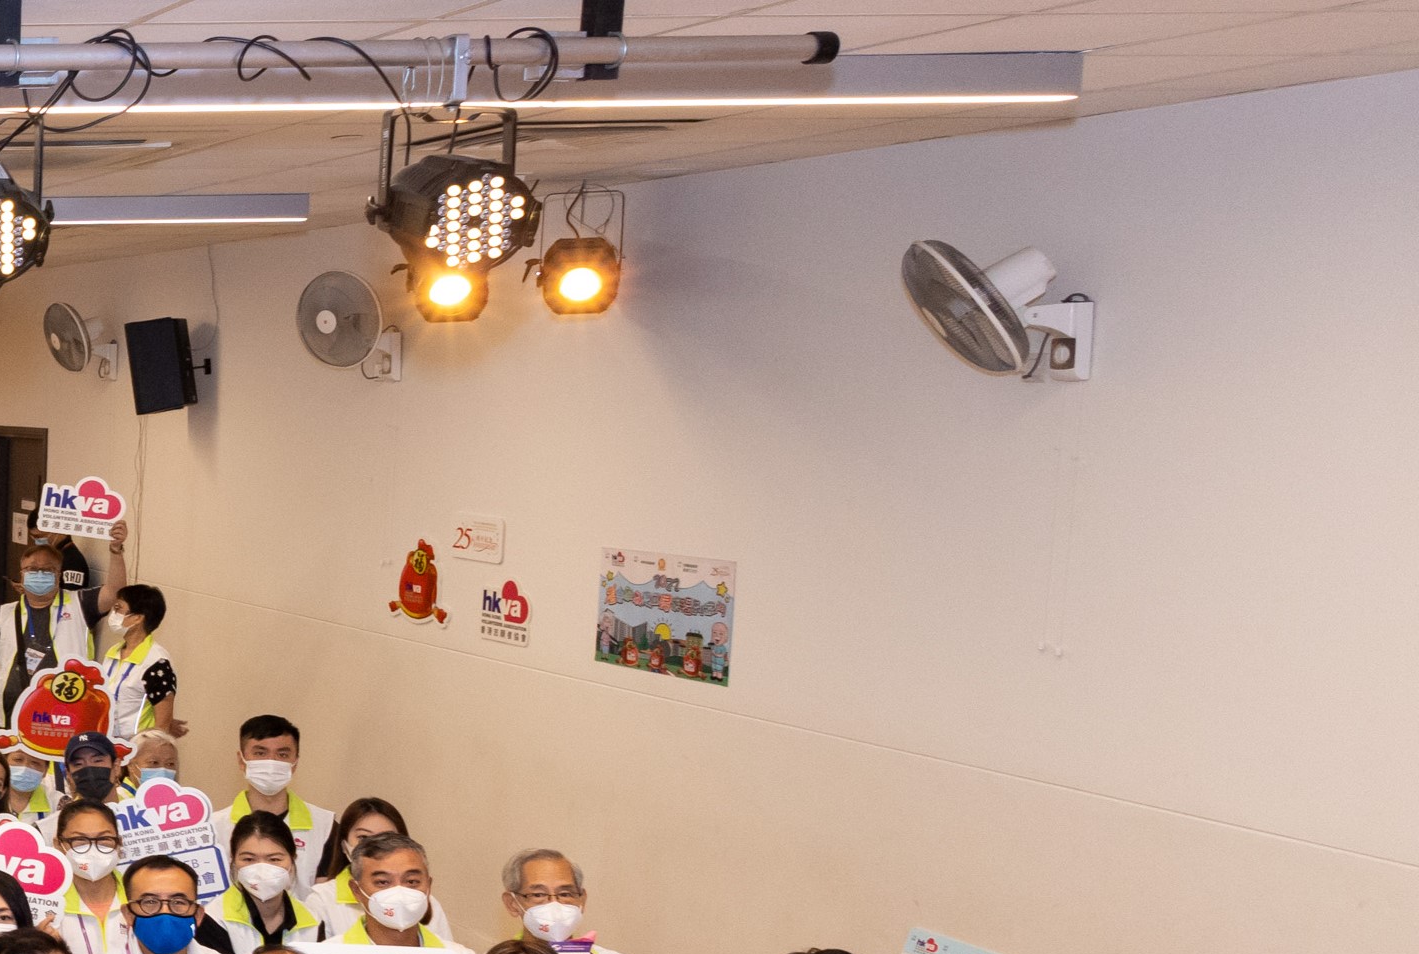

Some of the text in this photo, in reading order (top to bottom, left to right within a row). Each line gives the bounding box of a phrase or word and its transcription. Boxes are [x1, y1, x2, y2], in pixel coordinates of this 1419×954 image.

[45, 487, 109, 514] hkva
[452, 527, 472, 549] 25
[483, 589, 521, 618] hkva
[55, 675, 79, 700] 福
[32, 711, 71, 725] hkva
[162, 827, 208, 839] ASSOCIATION
